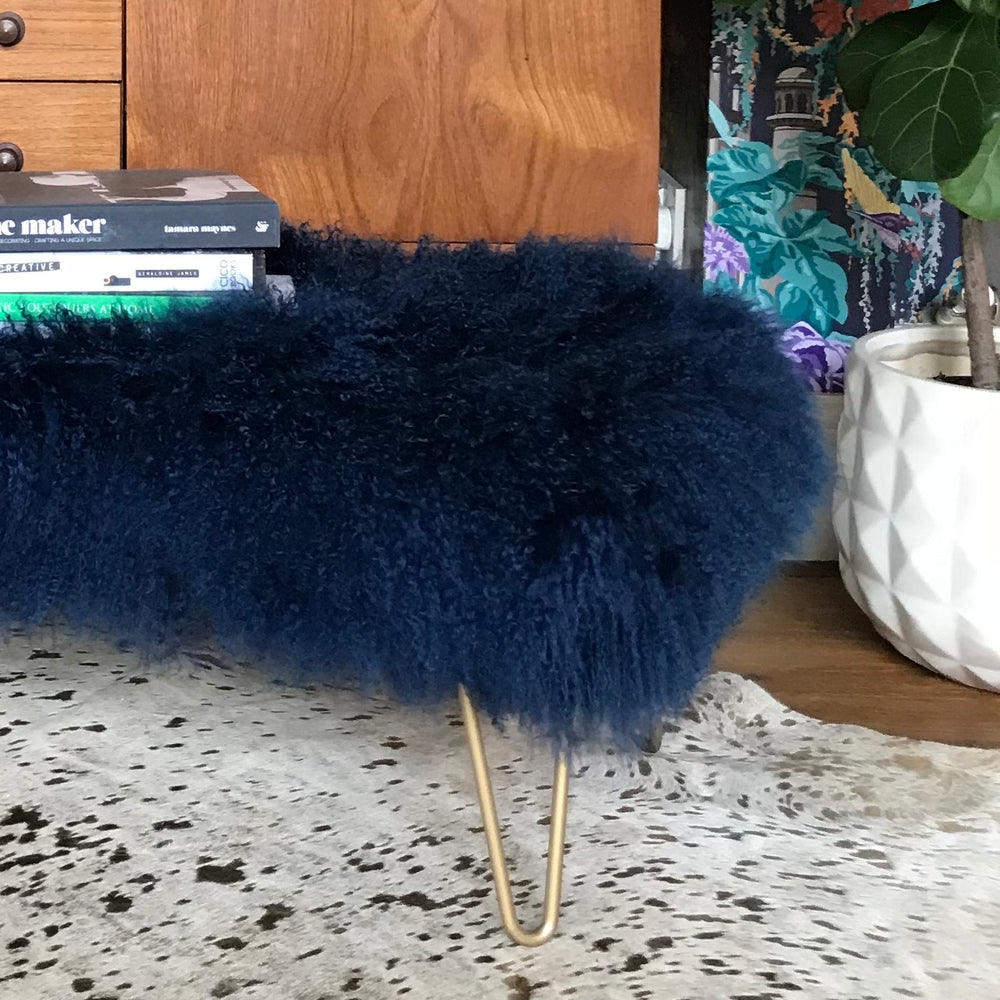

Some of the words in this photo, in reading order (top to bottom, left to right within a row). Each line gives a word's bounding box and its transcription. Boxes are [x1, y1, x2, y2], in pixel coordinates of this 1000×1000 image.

[20, 213, 107, 236] maker
[164, 225, 200, 233] tamara
[219, 259, 229, 287] CICO
